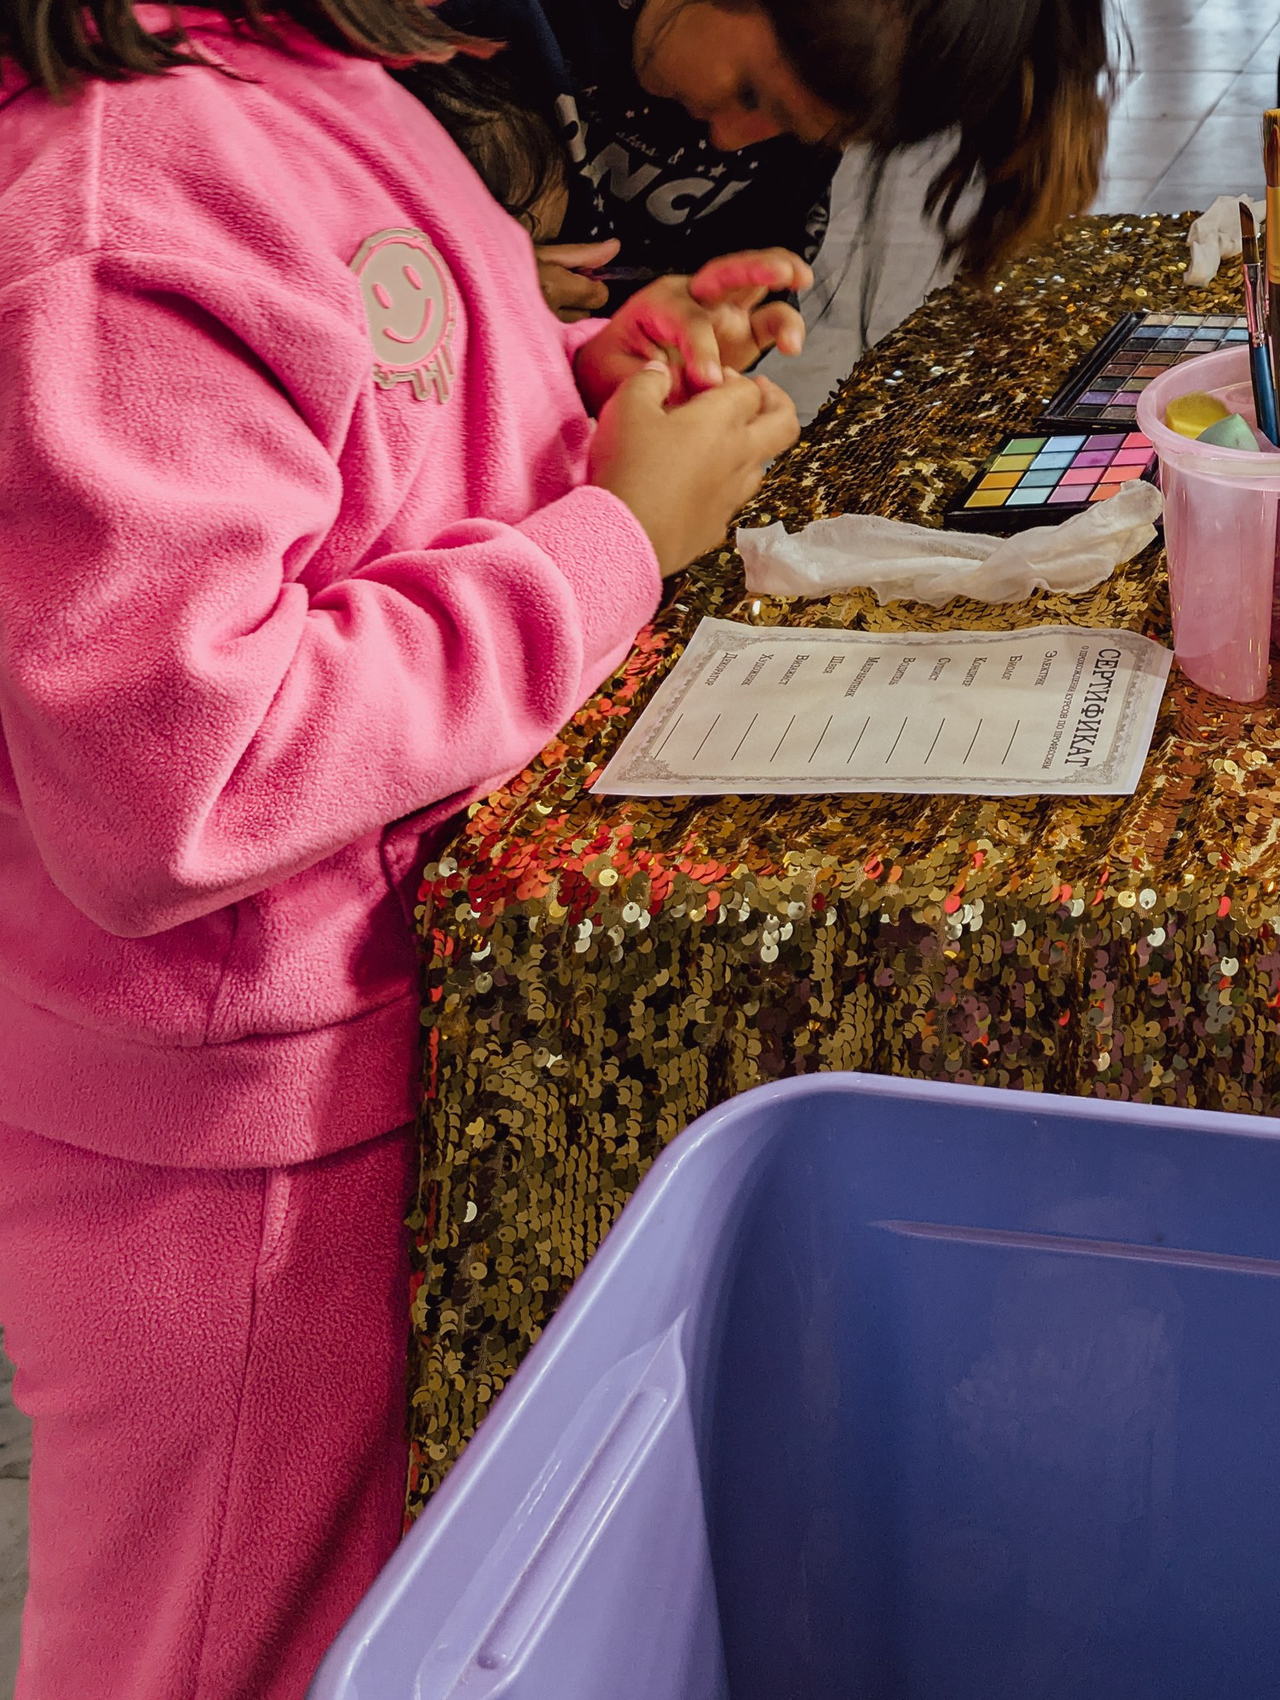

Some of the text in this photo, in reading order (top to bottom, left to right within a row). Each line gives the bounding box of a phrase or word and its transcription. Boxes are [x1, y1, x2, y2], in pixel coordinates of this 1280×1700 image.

[1059, 692, 1074, 719] КУРСОВ
[1064, 648, 1122, 768] СЕРТИФИКАТ
[1056, 720, 1067, 730] ПО
[1041, 730, 1063, 770] ПРОФЕССИЯМ
